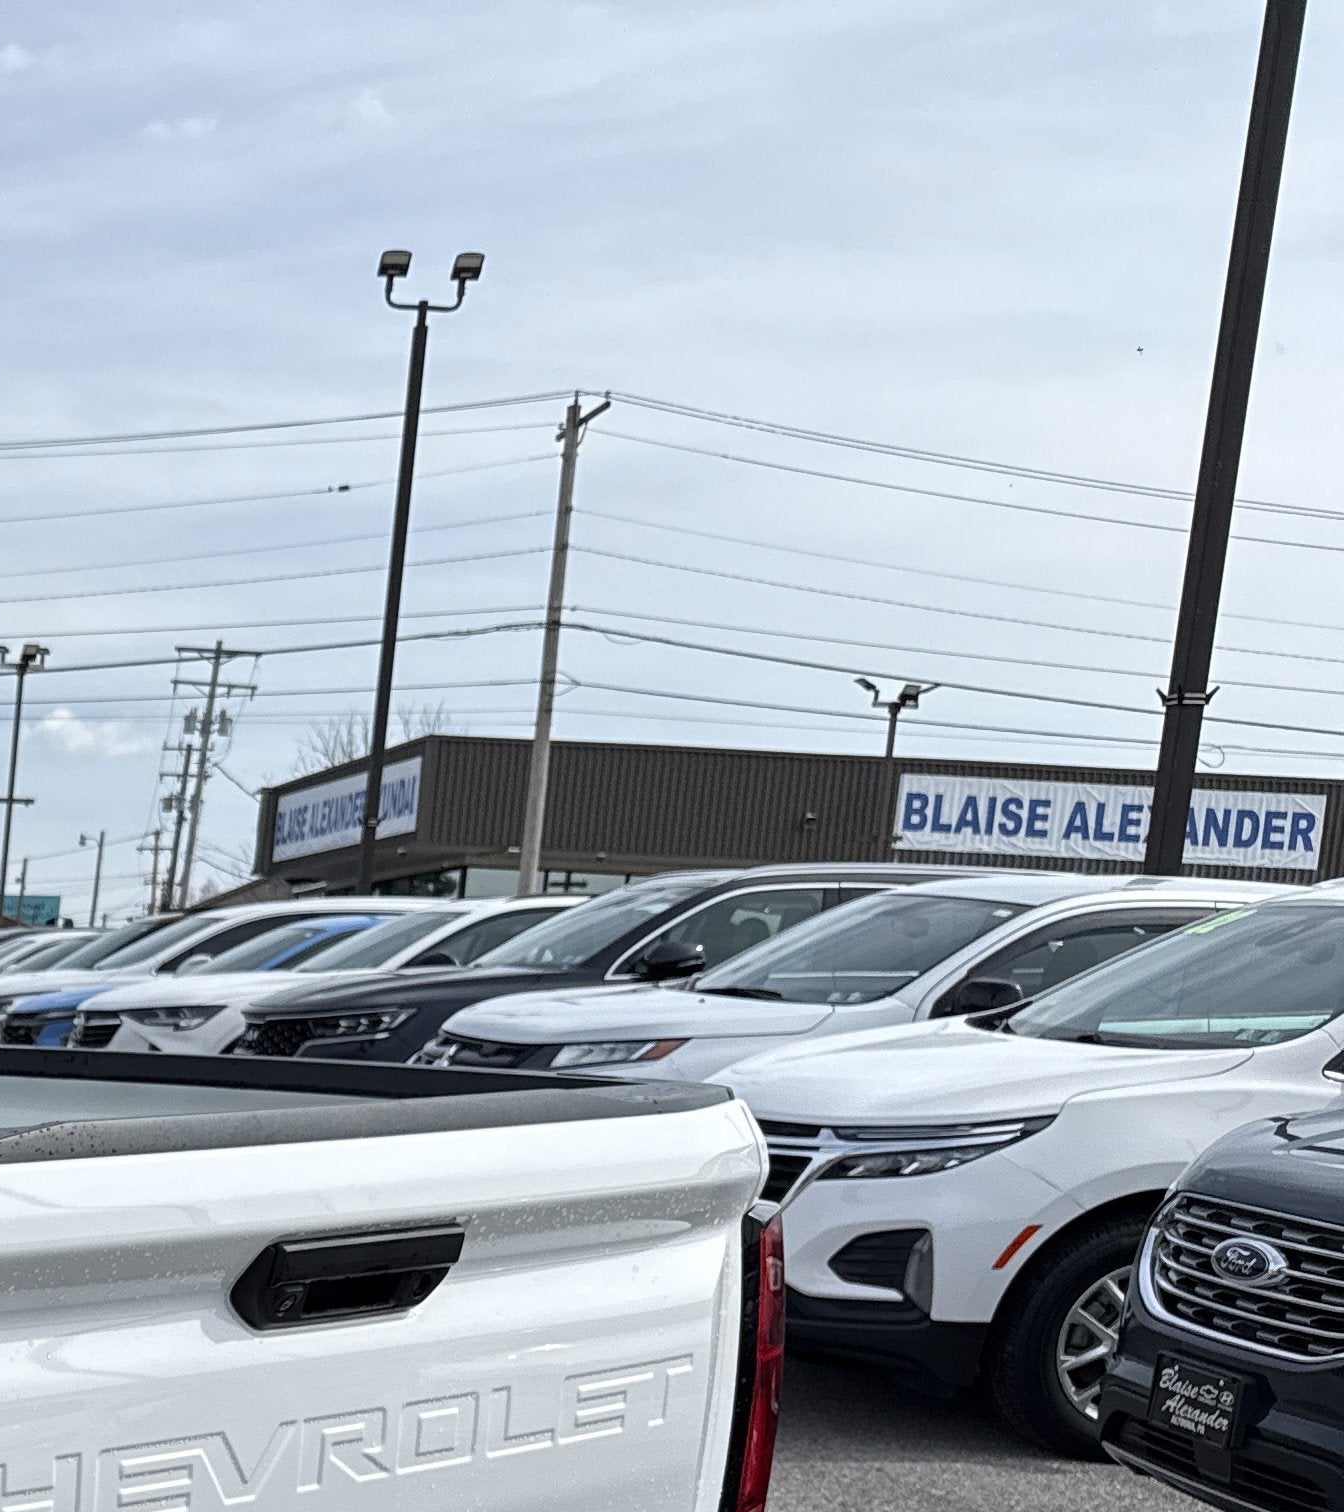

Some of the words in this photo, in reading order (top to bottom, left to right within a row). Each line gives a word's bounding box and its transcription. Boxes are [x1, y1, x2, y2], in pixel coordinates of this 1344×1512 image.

[902, 792, 1052, 838] BLAISE
[1062, 800, 1316, 853] ALEANDER
[1220, 1246, 1257, 1275] Ford
[1160, 1394, 1230, 1432] Alexander
